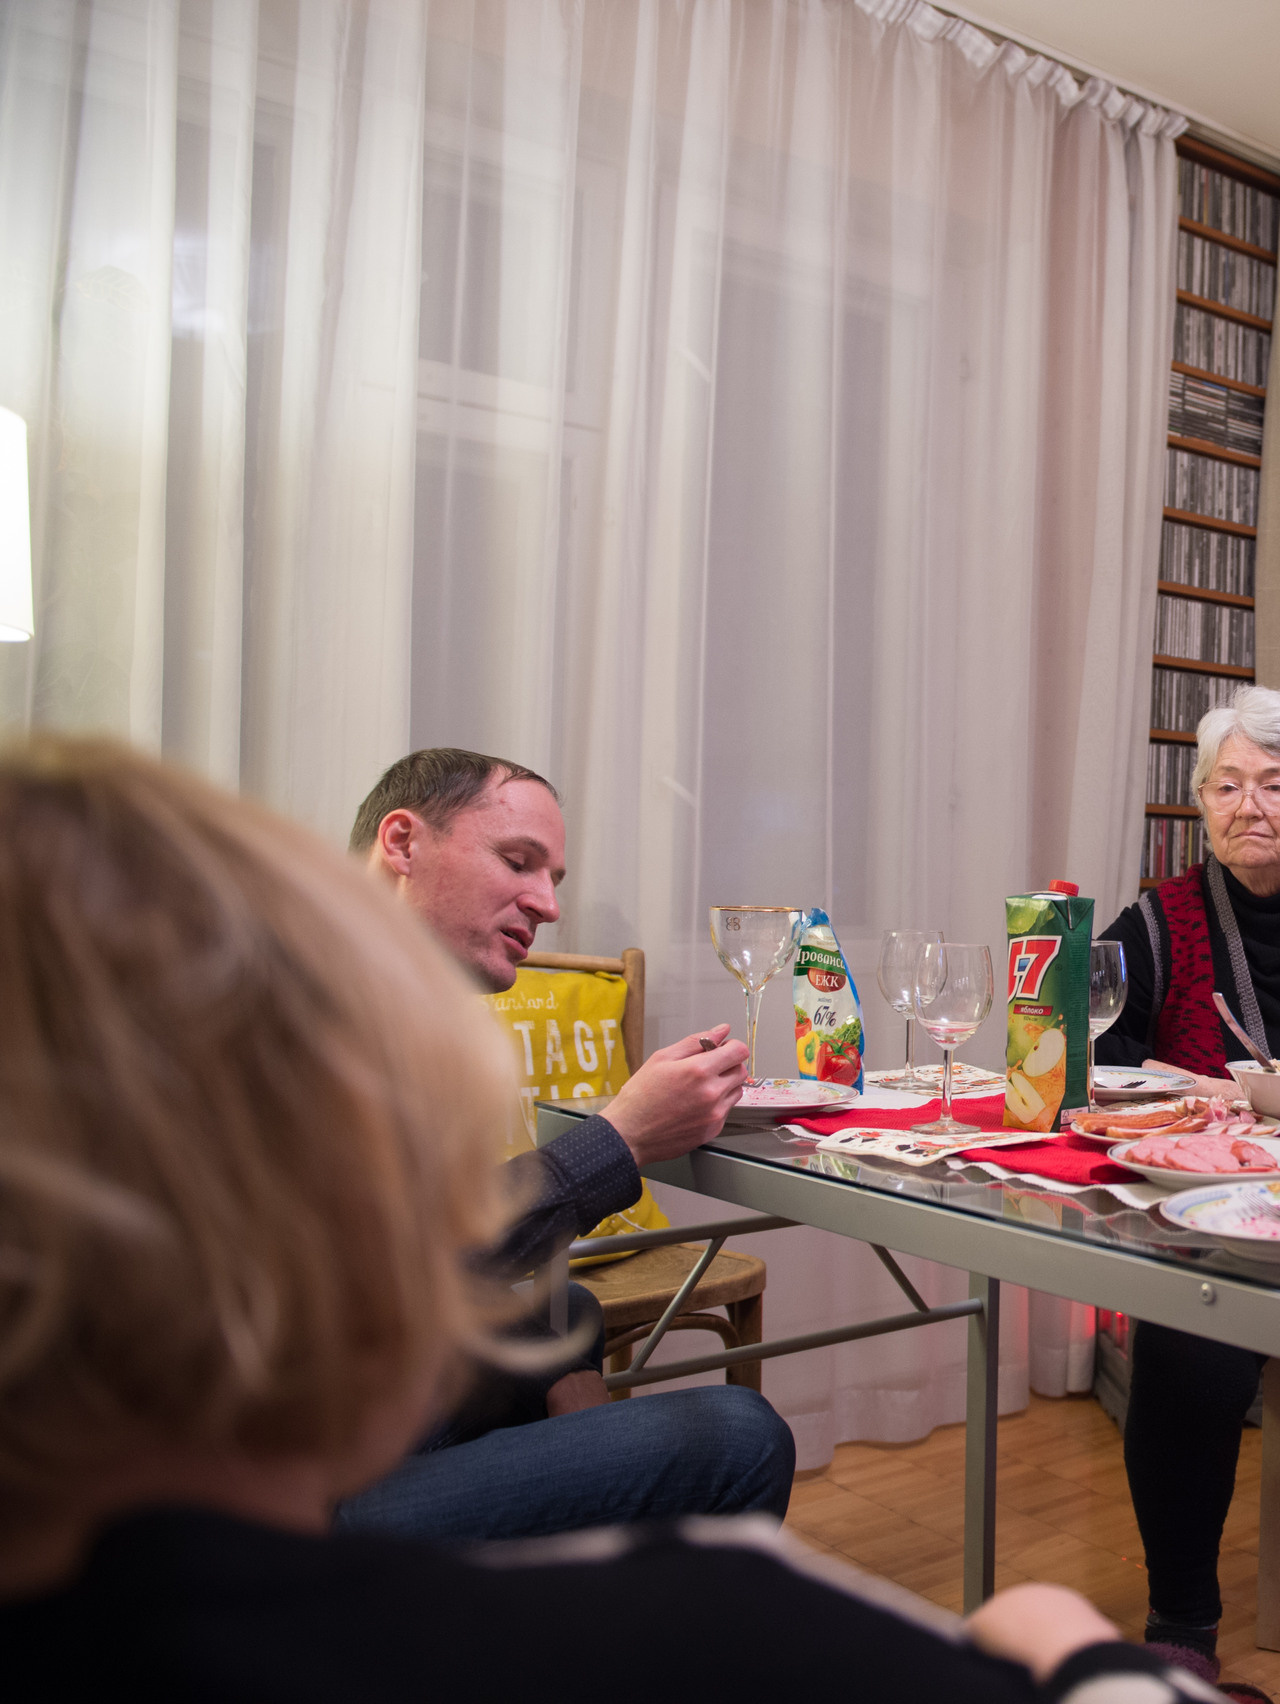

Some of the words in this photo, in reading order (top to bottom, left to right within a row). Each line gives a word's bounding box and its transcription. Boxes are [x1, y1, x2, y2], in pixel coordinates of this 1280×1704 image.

[815, 974, 839, 988] ЕЖК
[813, 1005, 837, 1027] 67%
[1020, 1006, 1044, 1015] яблоко
